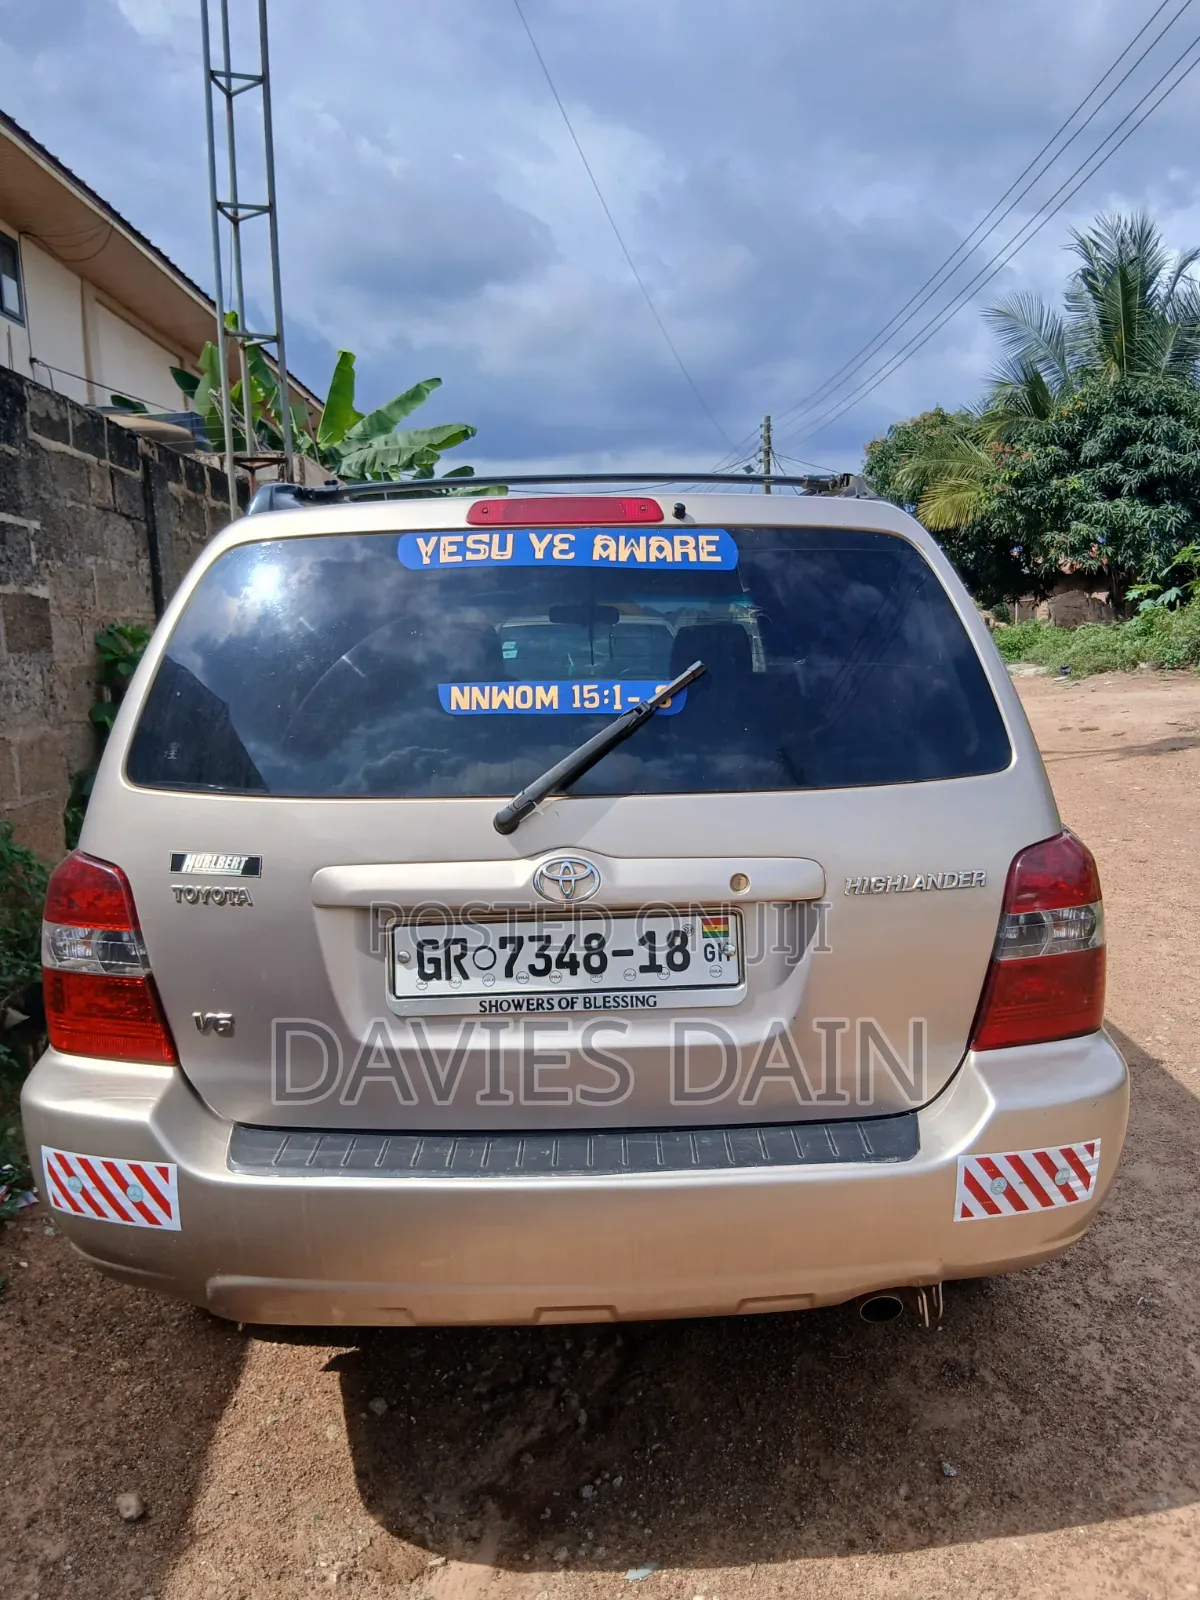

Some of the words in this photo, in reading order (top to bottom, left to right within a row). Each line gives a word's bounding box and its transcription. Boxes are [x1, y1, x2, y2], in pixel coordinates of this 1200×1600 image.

[416, 533, 514, 565] YESU
[592, 534, 722, 563] AWARE
[450, 685, 559, 710] NNWOM
[182, 854, 249, 873] HURLBERT
[844, 869, 987, 896] HIGHLANDER
[171, 884, 254, 906] TOYOTA
[416, 938, 470, 981] GR
[498, 930, 691, 979] 7348-18
[479, 997, 555, 1013] SHOWERS
[558, 996, 579, 1010] OF
[583, 994, 658, 1010] BLESSING
[192, 1011, 235, 1034] V6
